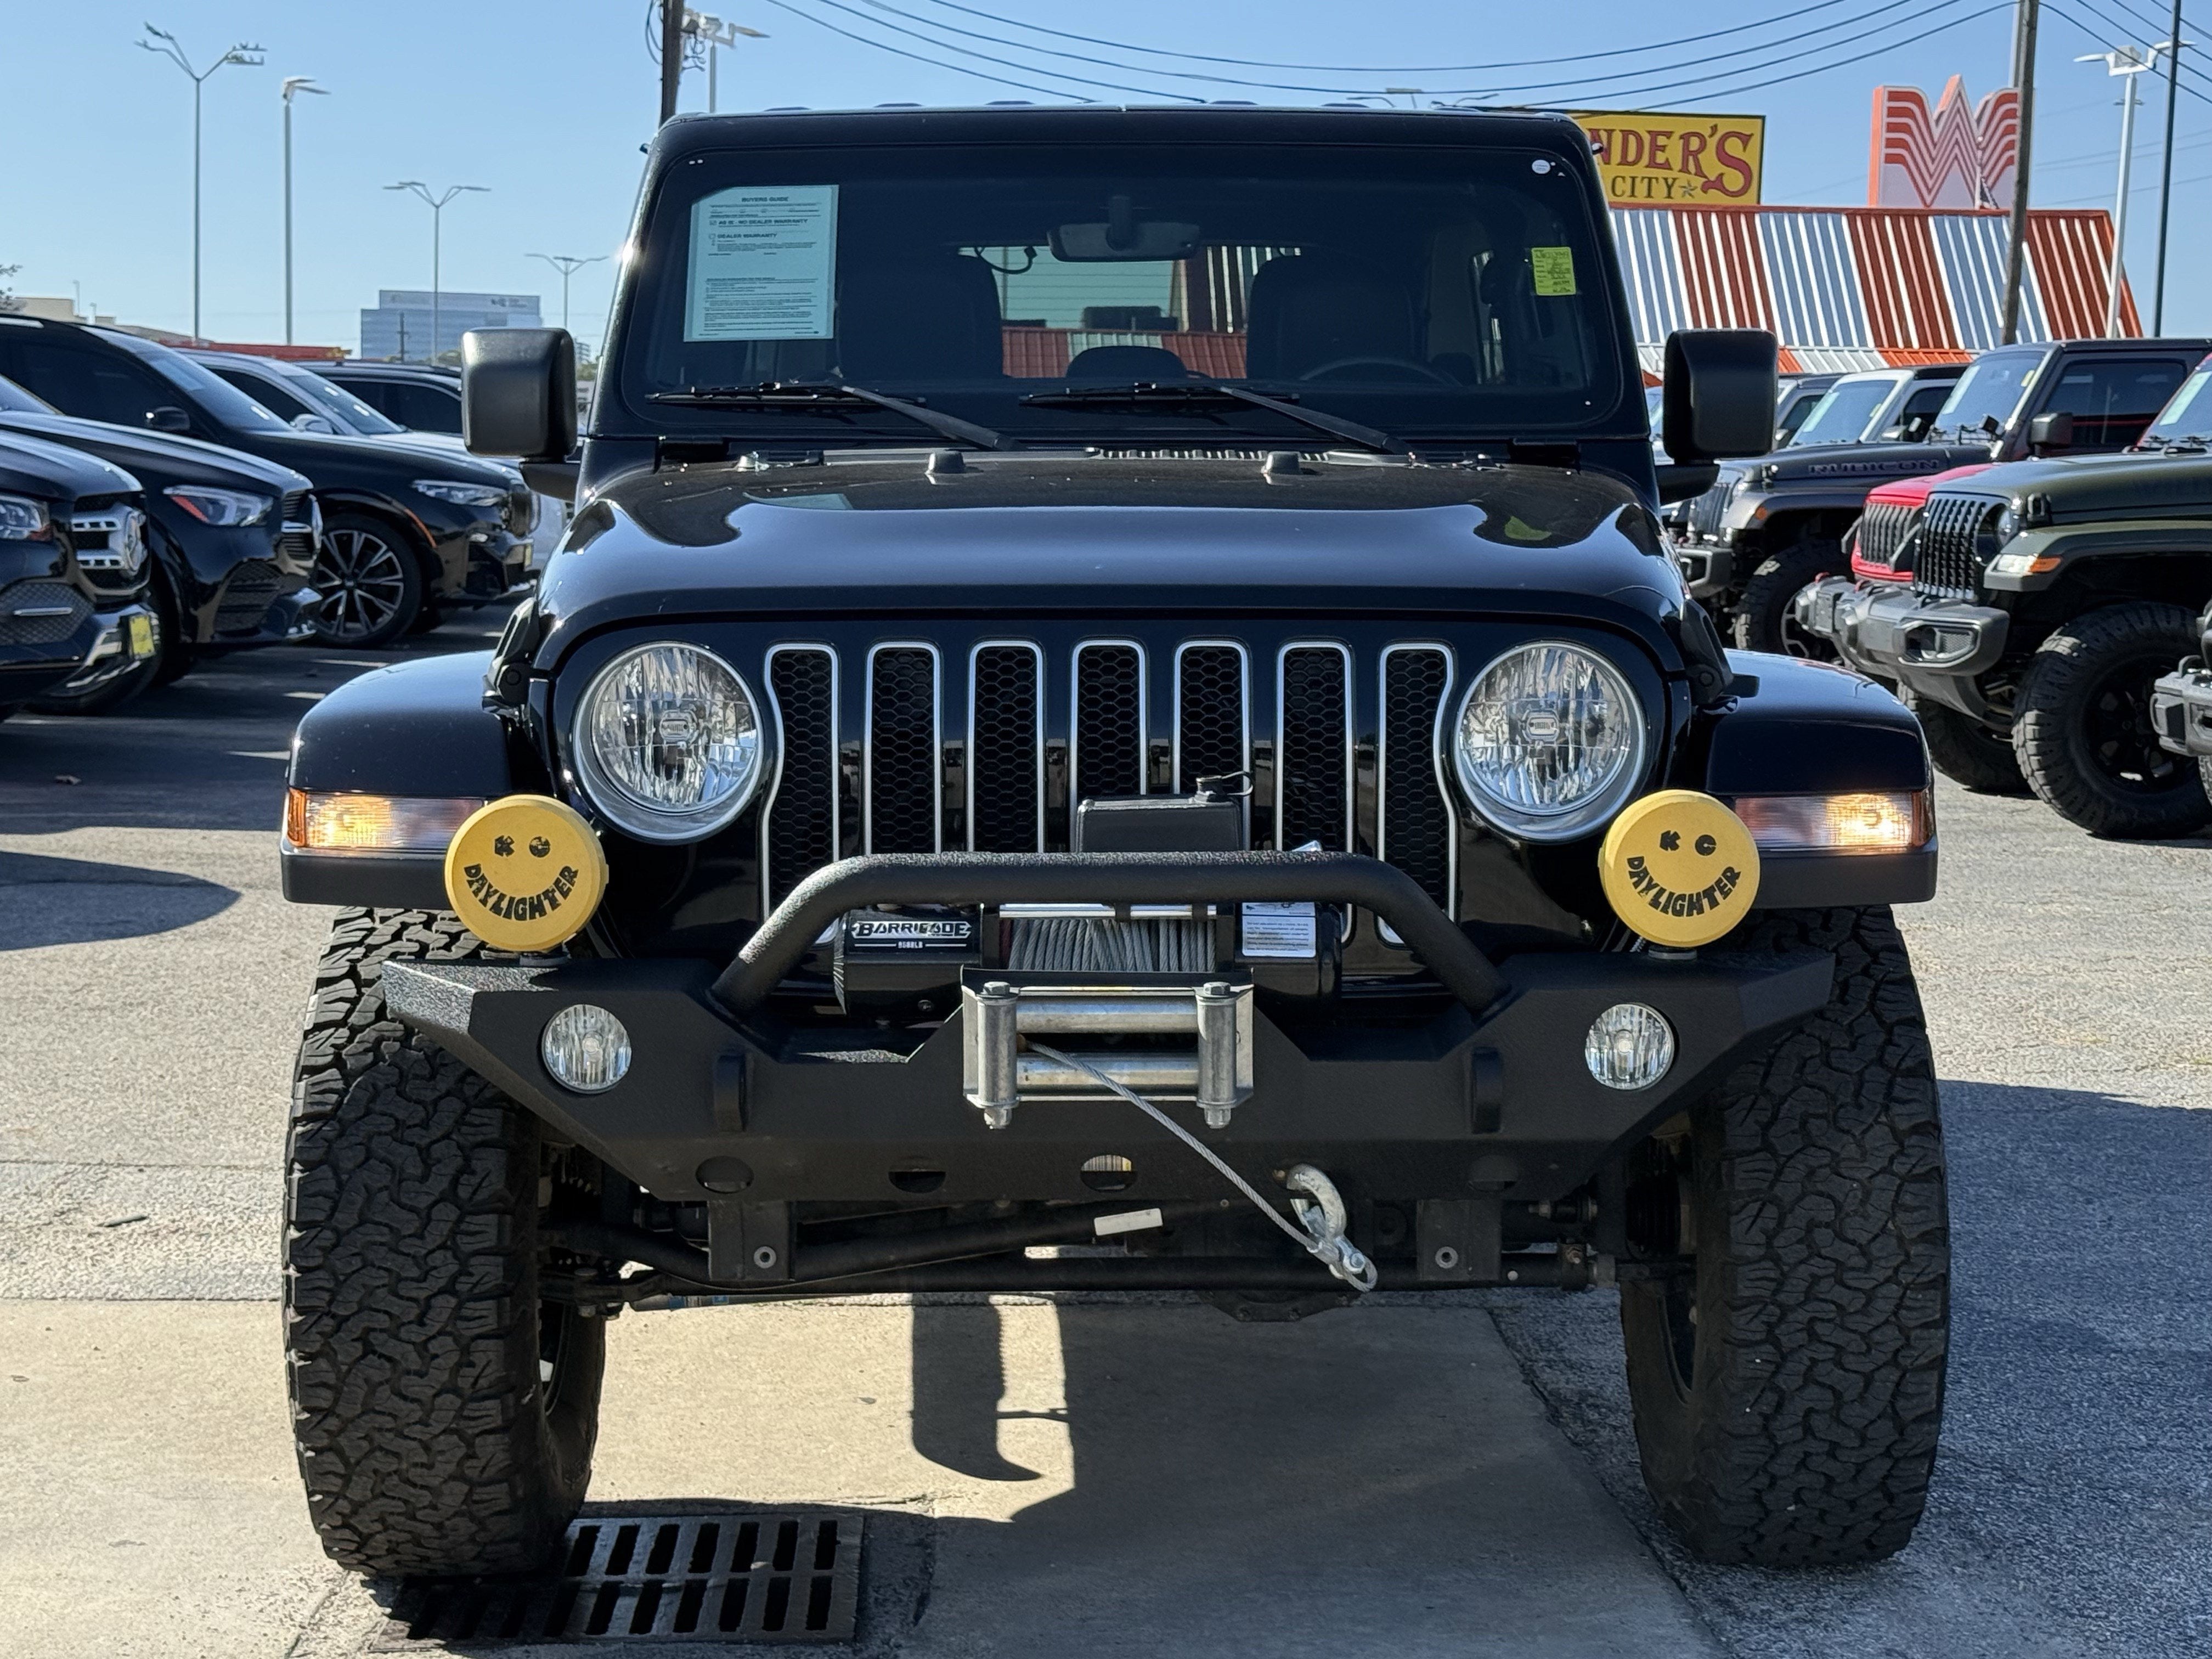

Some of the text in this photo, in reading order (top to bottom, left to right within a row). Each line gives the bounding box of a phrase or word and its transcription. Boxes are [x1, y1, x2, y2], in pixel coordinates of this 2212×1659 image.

[1611, 176, 1678, 199] CITY
[1809, 460, 1940, 474] RUBICON
[464, 863, 579, 922] DAYLIGHTER
[1626, 855, 1742, 917] DAYLIGHTER
[853, 922, 972, 938] BARRICADE
